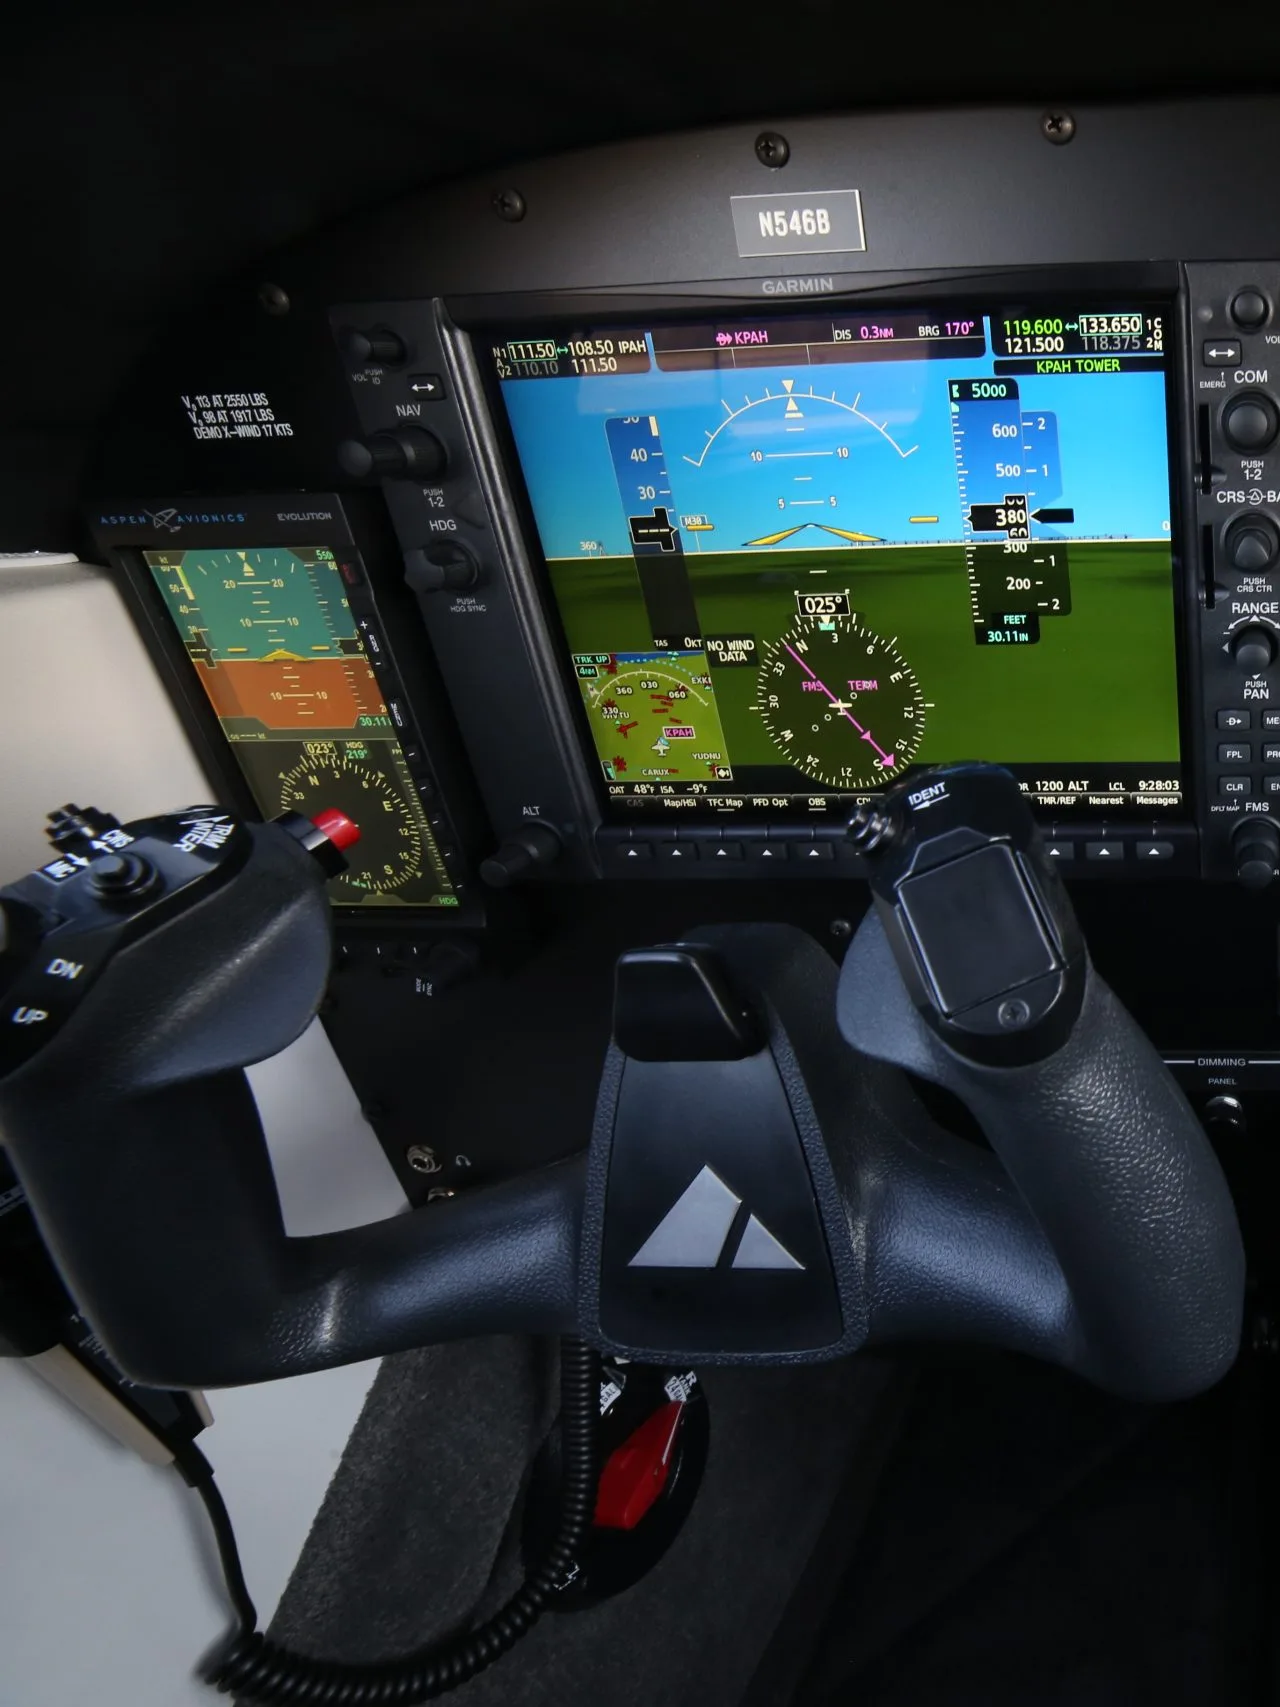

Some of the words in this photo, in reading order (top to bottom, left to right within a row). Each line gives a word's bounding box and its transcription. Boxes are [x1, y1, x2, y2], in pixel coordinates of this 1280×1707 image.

[759, 208, 830, 237] N546B
[762, 277, 833, 294] GARMIN
[1003, 320, 1062, 335] 119.600
[1081, 317, 1140, 333] 133.650
[734, 331, 768, 344] KPAH
[510, 343, 555, 359] 111.50
[568, 340, 613, 356] 108.50
[618, 340, 646, 353] IPAH
[1005, 337, 1064, 353] 121.500
[1082, 336, 1141, 351] 118.375
[513, 361, 558, 376] 110.10
[572, 359, 617, 373] 111.50
[1037, 360, 1070, 372] KPAH
[1075, 359, 1120, 372] TOWER
[1234, 370, 1268, 383] COM
[972, 383, 1006, 397] 5000
[212, 395, 224, 407] AT
[224, 394, 249, 407] 2550
[248, 393, 268, 405] LBS
[203, 411, 216, 423] 98
[217, 410, 228, 422] AT
[230, 410, 252, 422] 1917
[254, 408, 274, 421] LBS
[396, 405, 420, 416] NAV
[194, 426, 222, 439] DEMO
[262, 424, 272, 436] 17
[274, 423, 293, 436] KTS
[992, 424, 1017, 438] 600
[996, 464, 1020, 476] 500
[428, 497, 444, 507] 1-2
[101, 516, 146, 524] ASPEN
[178, 513, 244, 522] AVIONICS
[278, 512, 331, 521] EVOLUTION
[429, 520, 456, 531] HDG
[1006, 577, 1030, 590] 200
[805, 596, 842, 613] 025°
[1232, 602, 1279, 613] RANGE
[1004, 615, 1026, 624] FEET
[707, 642, 724, 651] NO
[728, 640, 755, 650] WIND
[719, 651, 747, 661] DATA
[1244, 689, 1269, 699] PAN
[307, 743, 333, 753] 023°
[1036, 781, 1063, 791] 1200
[1068, 781, 1089, 790] ALT
[1139, 780, 1179, 791] 9:28:03
[908, 782, 946, 805] IDENT
[523, 806, 539, 816] ALT
[1246, 803, 1269, 811] FMS
[46, 959, 83, 979] DN
[12, 1007, 48, 1024] UP
[1197, 1058, 1246, 1067] DIMMING
